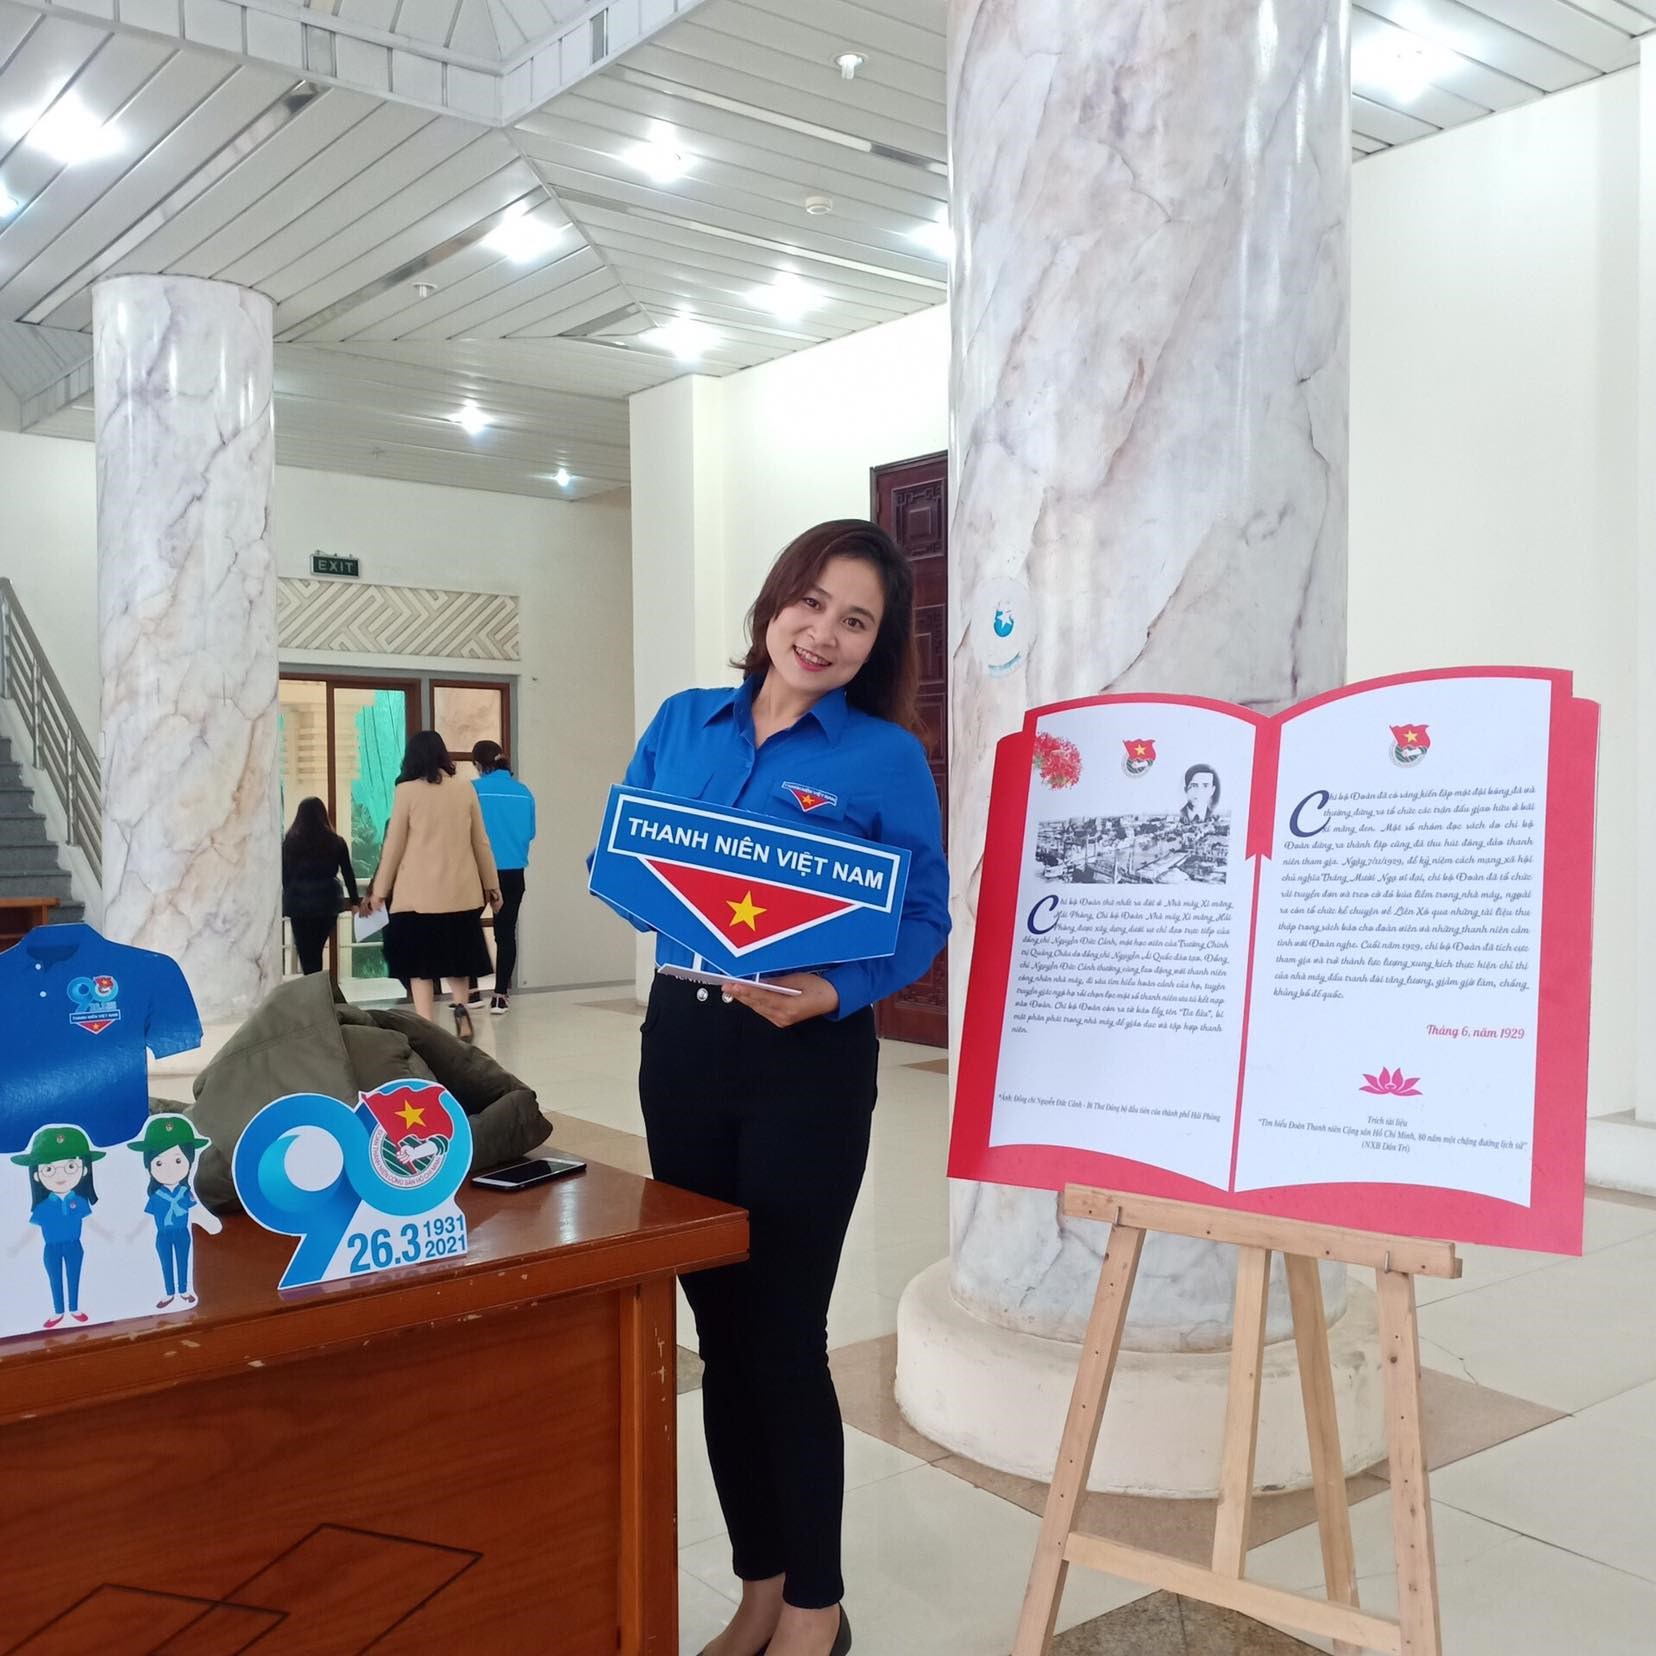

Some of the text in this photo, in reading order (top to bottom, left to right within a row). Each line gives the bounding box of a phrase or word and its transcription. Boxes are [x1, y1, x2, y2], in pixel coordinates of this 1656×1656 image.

[318, 559, 354, 573] EXIT
[628, 817, 884, 889] THANH NIÊN VIỆT NAM
[1427, 1024, 1459, 1039] Tháng
[1473, 1028, 1497, 1038] năm
[1500, 1028, 1525, 1039] 1929
[233, 1079, 472, 1288] 90
[348, 1215, 466, 1273] 26.3 1931 2021
